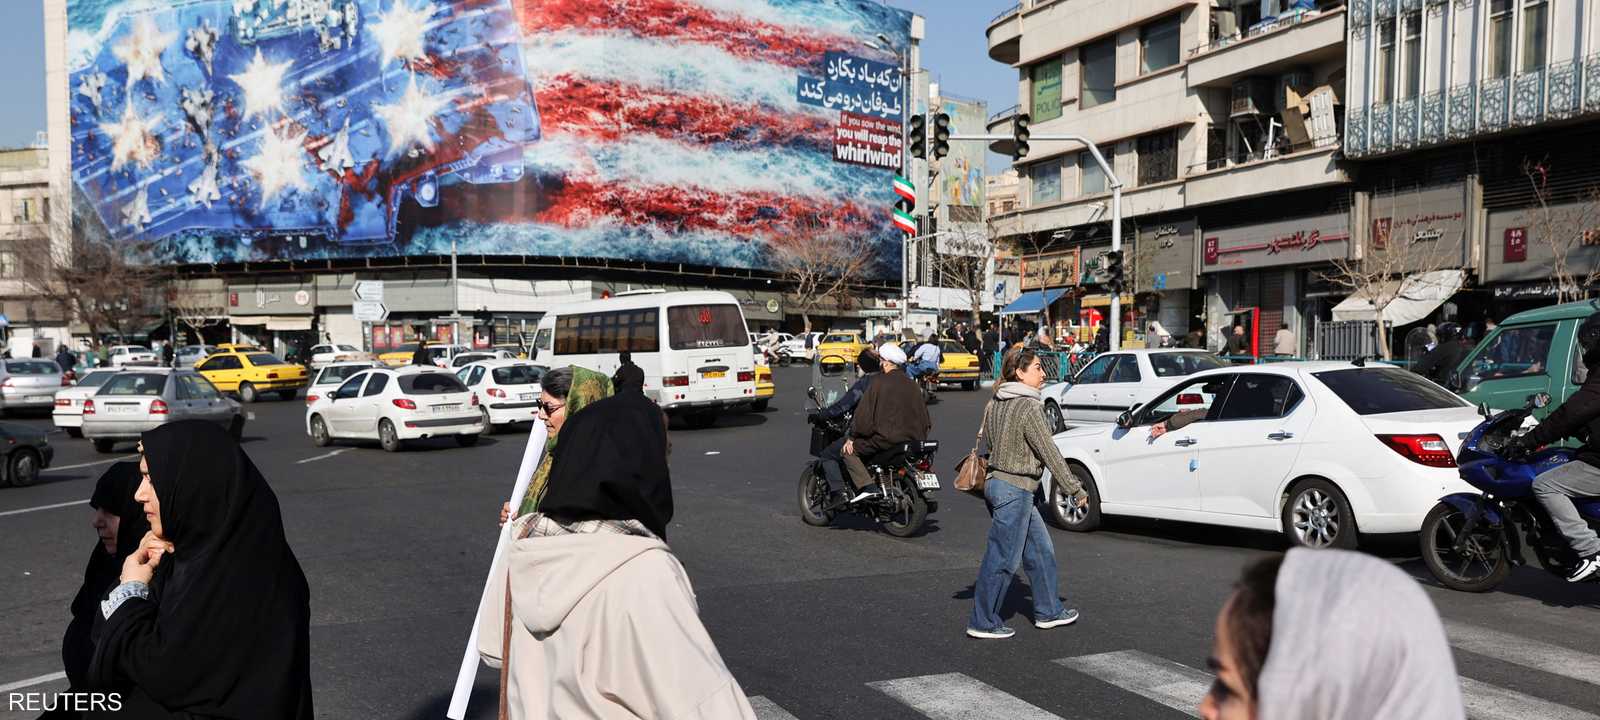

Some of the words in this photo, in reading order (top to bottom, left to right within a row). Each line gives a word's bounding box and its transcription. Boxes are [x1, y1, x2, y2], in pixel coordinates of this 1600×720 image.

[827, 57, 856, 84] بکارد
[858, 62, 876, 88] باد
[861, 91, 902, 118] طوفان
[848, 117, 861, 126] you
[861, 119, 874, 129] sow
[875, 121, 886, 131] the
[836, 128, 853, 140] you
[854, 129, 868, 142] will
[869, 133, 888, 146] reap
[888, 135, 902, 147] the
[836, 141, 902, 169] whirlwind
